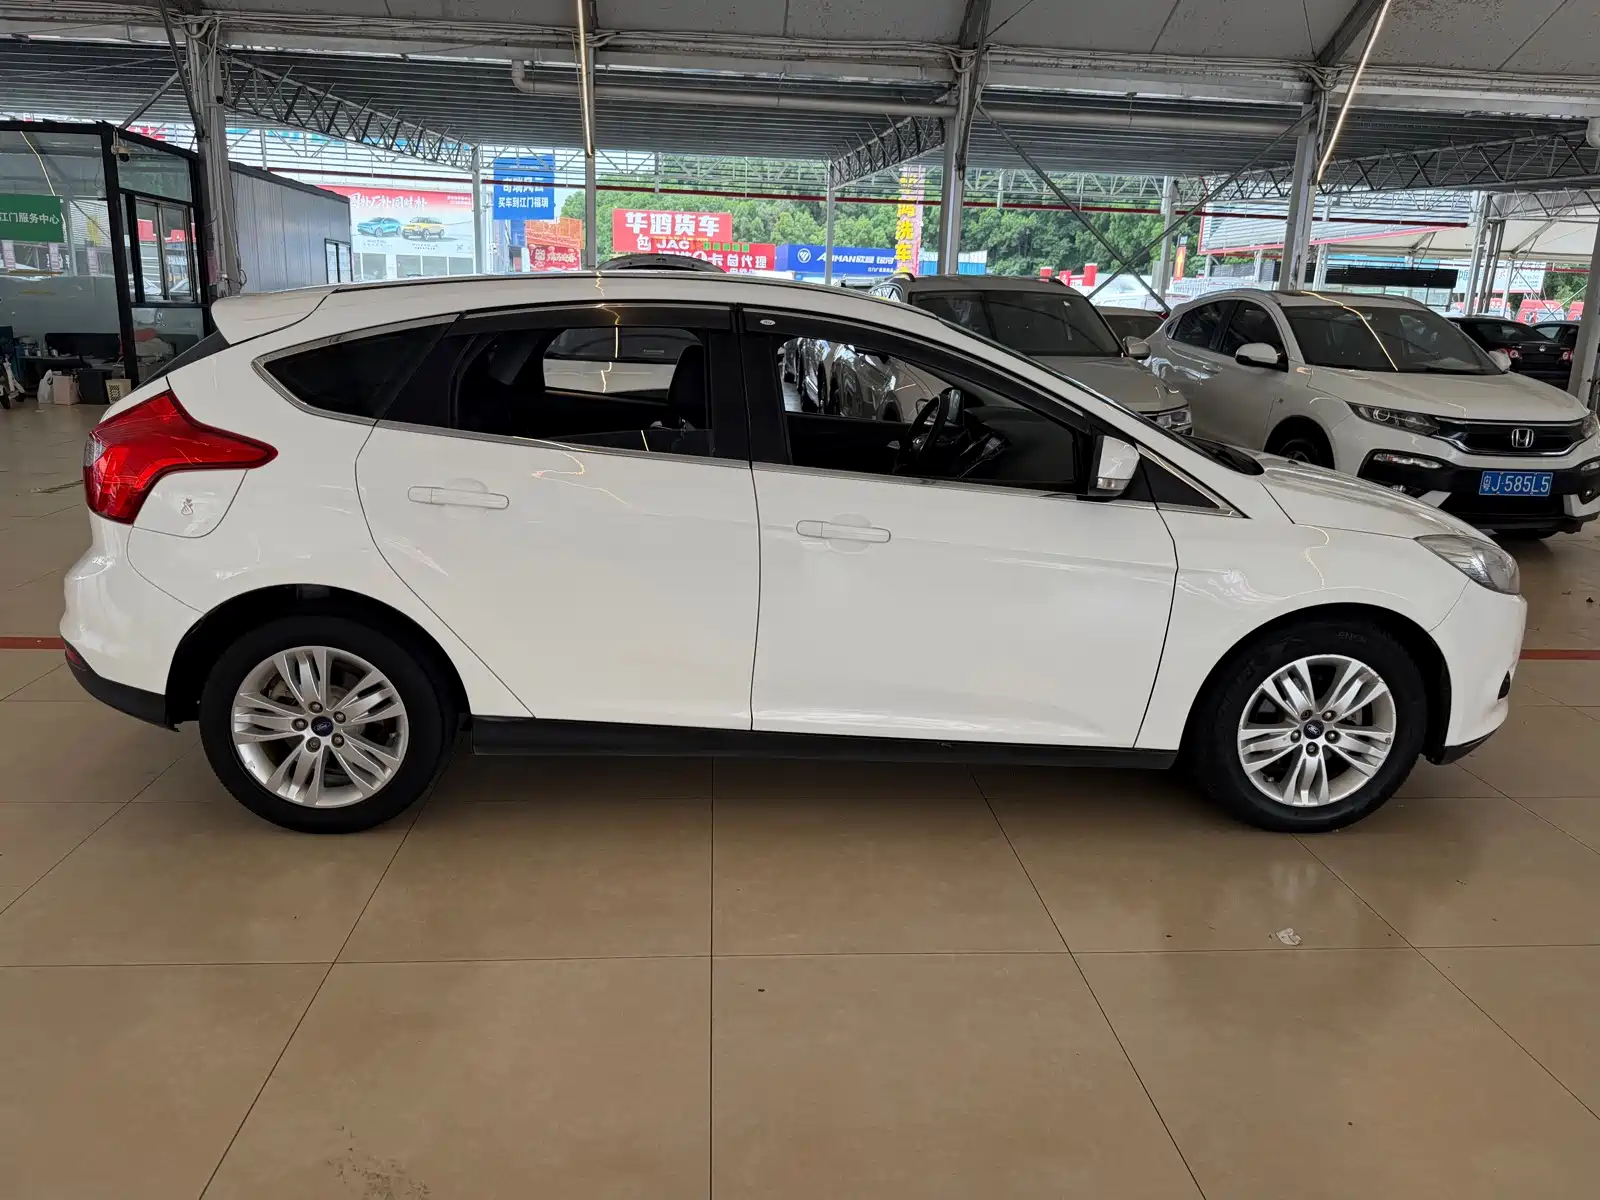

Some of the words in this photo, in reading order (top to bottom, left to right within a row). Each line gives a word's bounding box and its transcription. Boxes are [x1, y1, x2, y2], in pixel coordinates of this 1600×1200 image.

[625, 211, 720, 237] 华鸿货车
[656, 239, 690, 250] JAC
